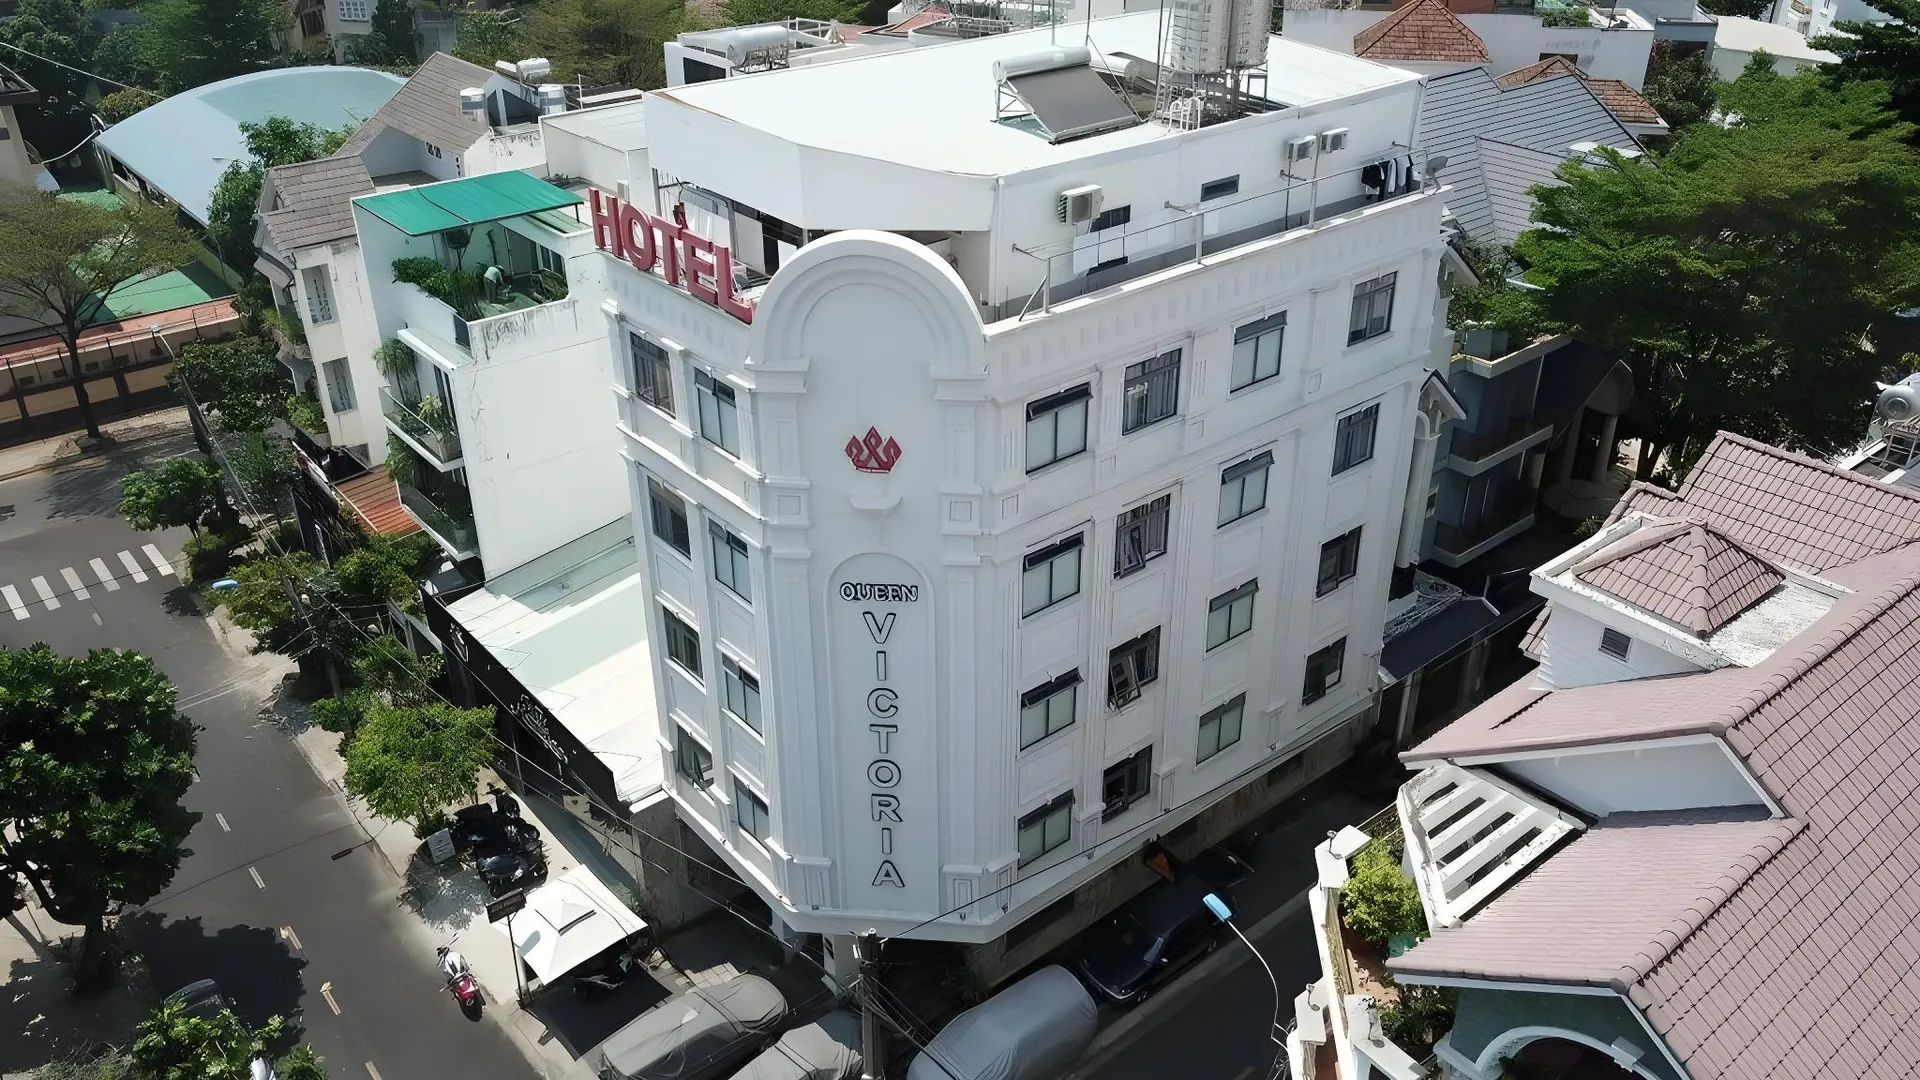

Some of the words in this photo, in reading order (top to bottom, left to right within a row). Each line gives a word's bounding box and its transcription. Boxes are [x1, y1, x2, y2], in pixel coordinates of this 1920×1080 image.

[588, 187, 753, 325] HOTEL
[840, 582, 918, 602] QUEEN
[862, 611, 905, 888] VICTORIA
